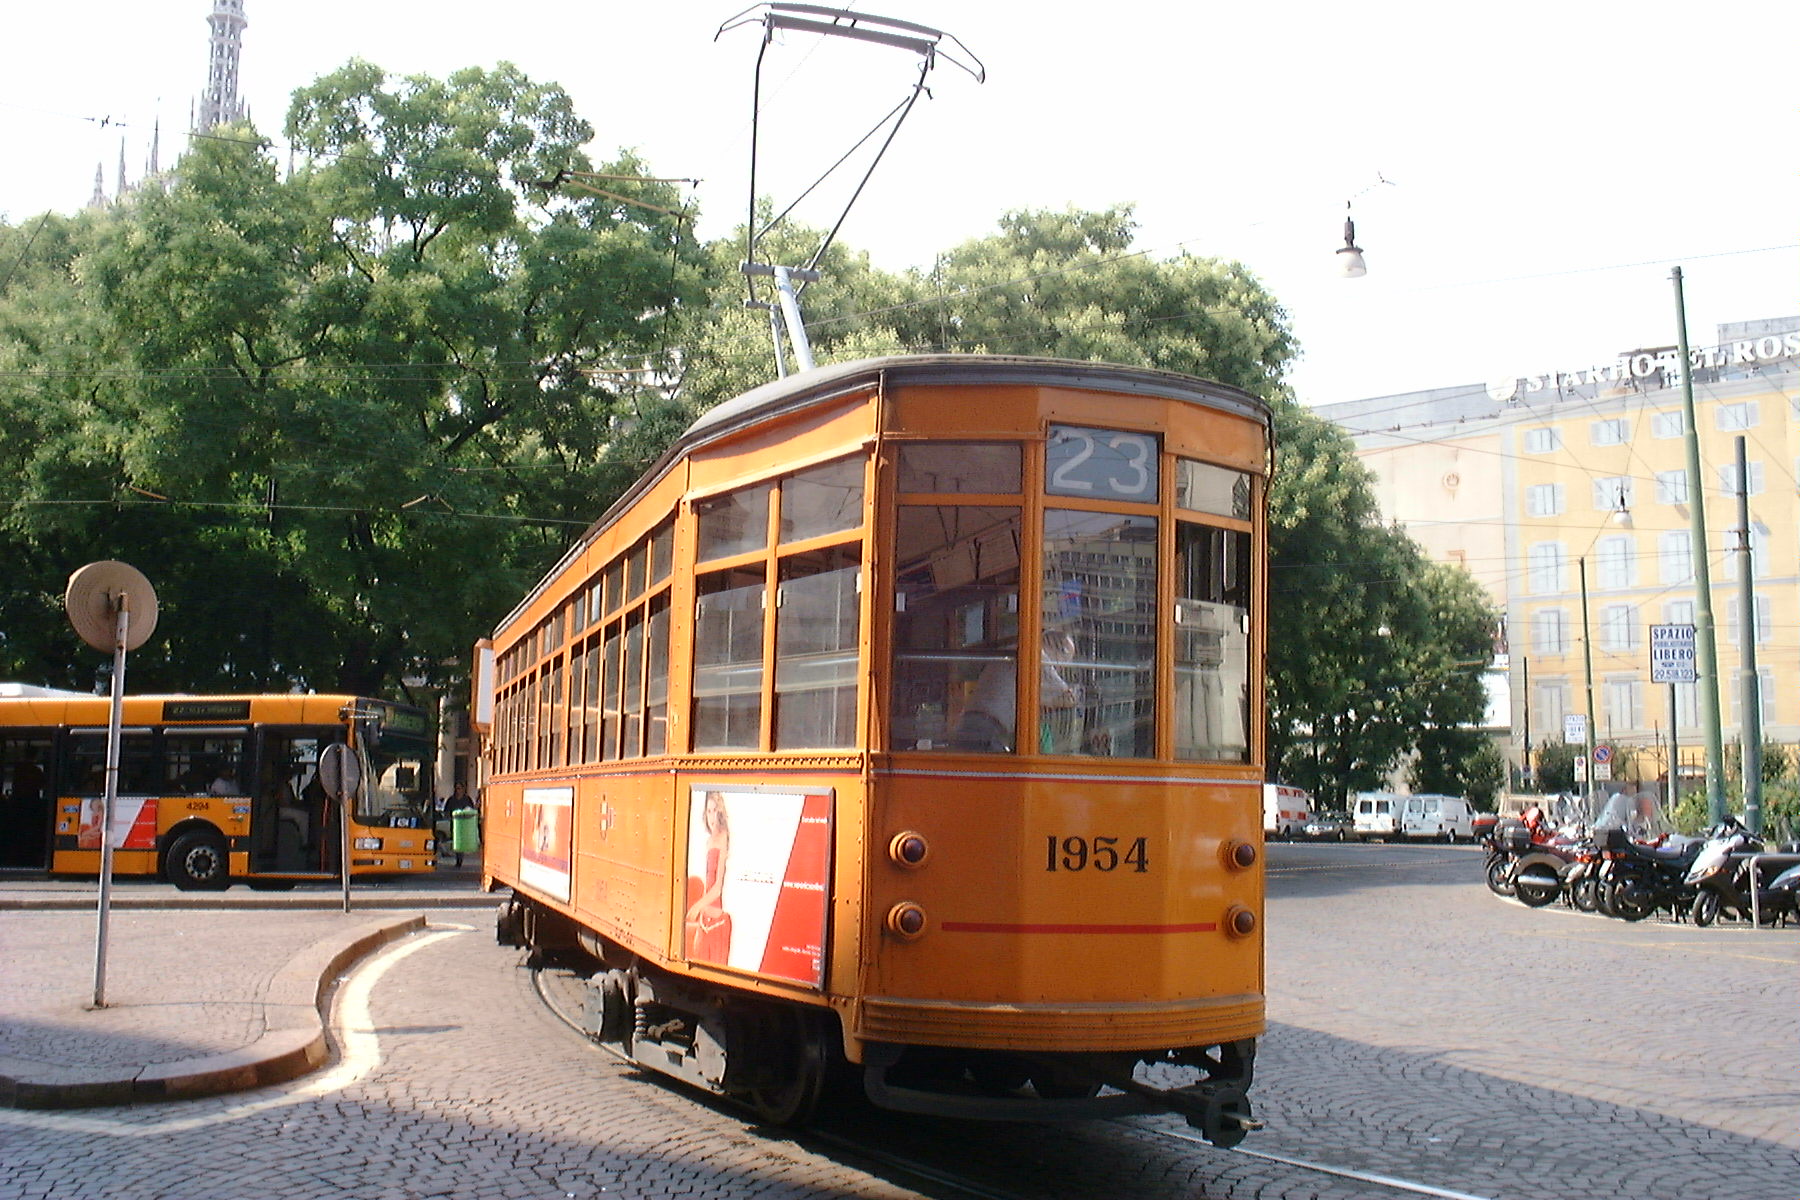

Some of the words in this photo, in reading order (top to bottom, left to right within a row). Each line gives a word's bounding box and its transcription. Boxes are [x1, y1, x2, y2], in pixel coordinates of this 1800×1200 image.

[1052, 428, 1149, 495] 23
[1653, 628, 1692, 639] SPAZIO
[1653, 649, 1693, 660] LIBERO
[1046, 836, 1149, 873] 1954
